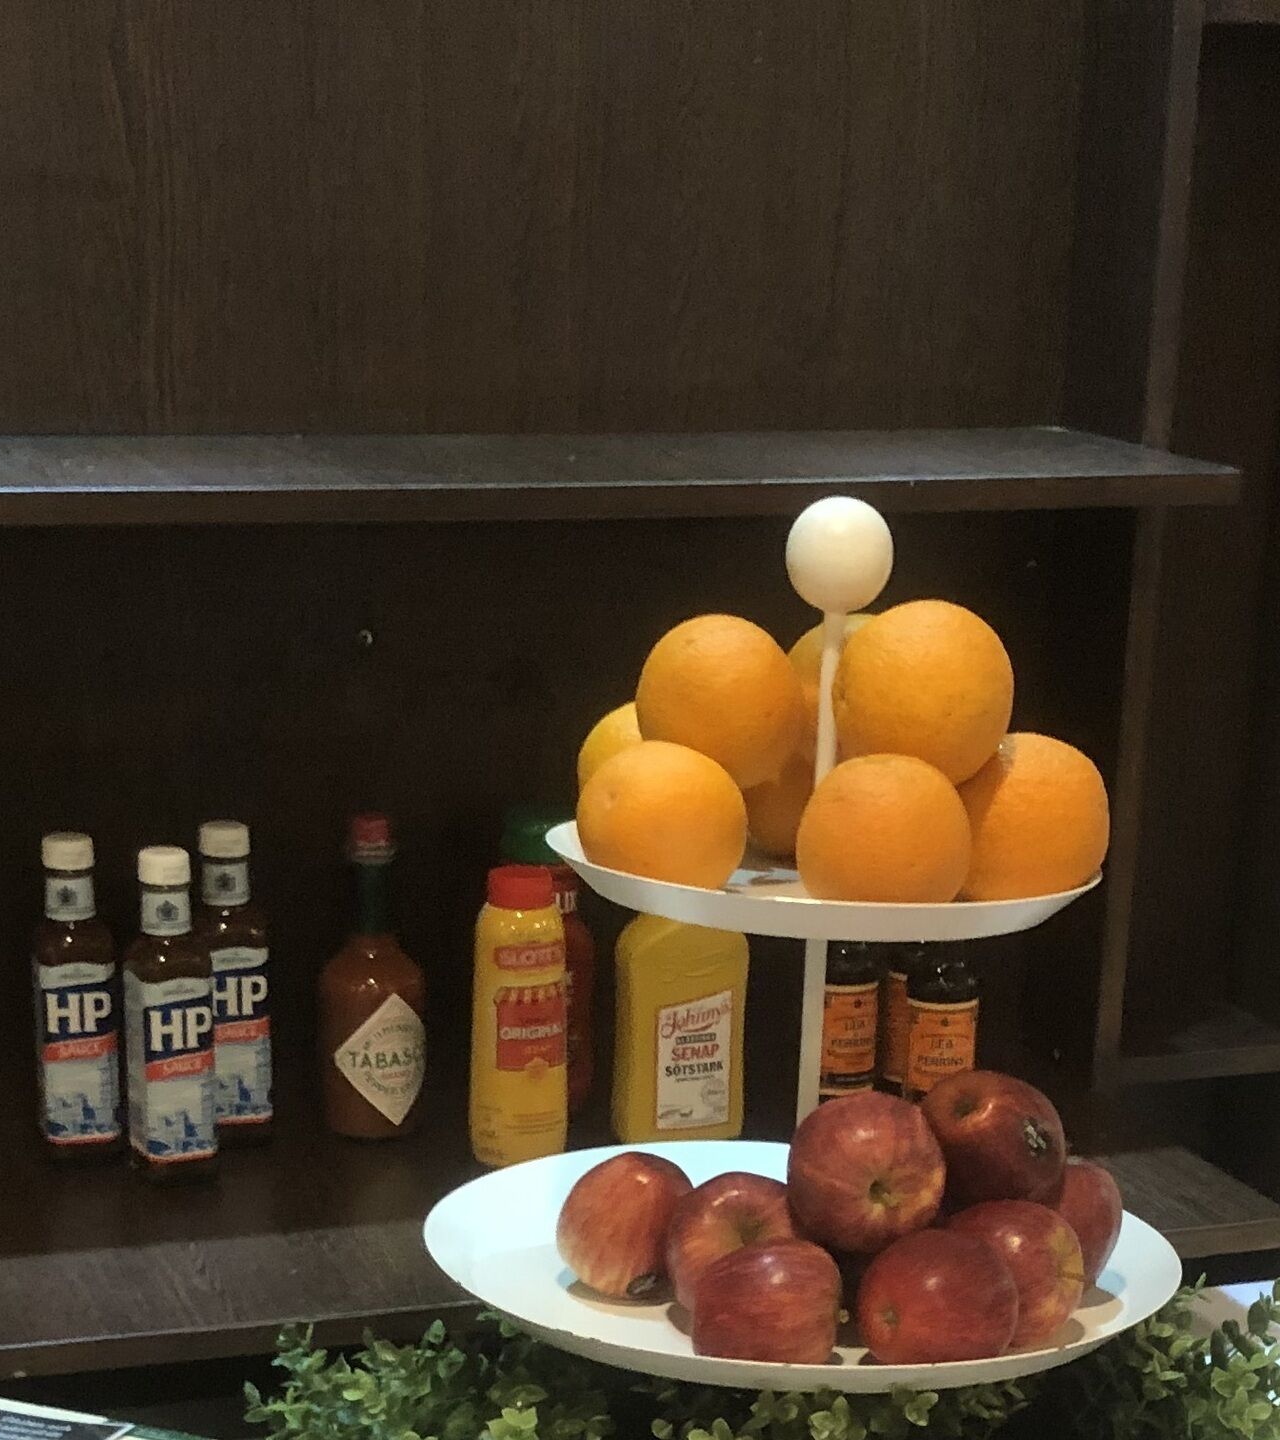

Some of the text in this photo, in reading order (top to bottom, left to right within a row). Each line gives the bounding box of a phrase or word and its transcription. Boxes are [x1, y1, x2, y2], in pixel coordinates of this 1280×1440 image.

[46, 991, 112, 1034] HP
[213, 975, 268, 1017] HP
[149, 1006, 212, 1052] HP
[671, 1043, 720, 1062] SENAP
